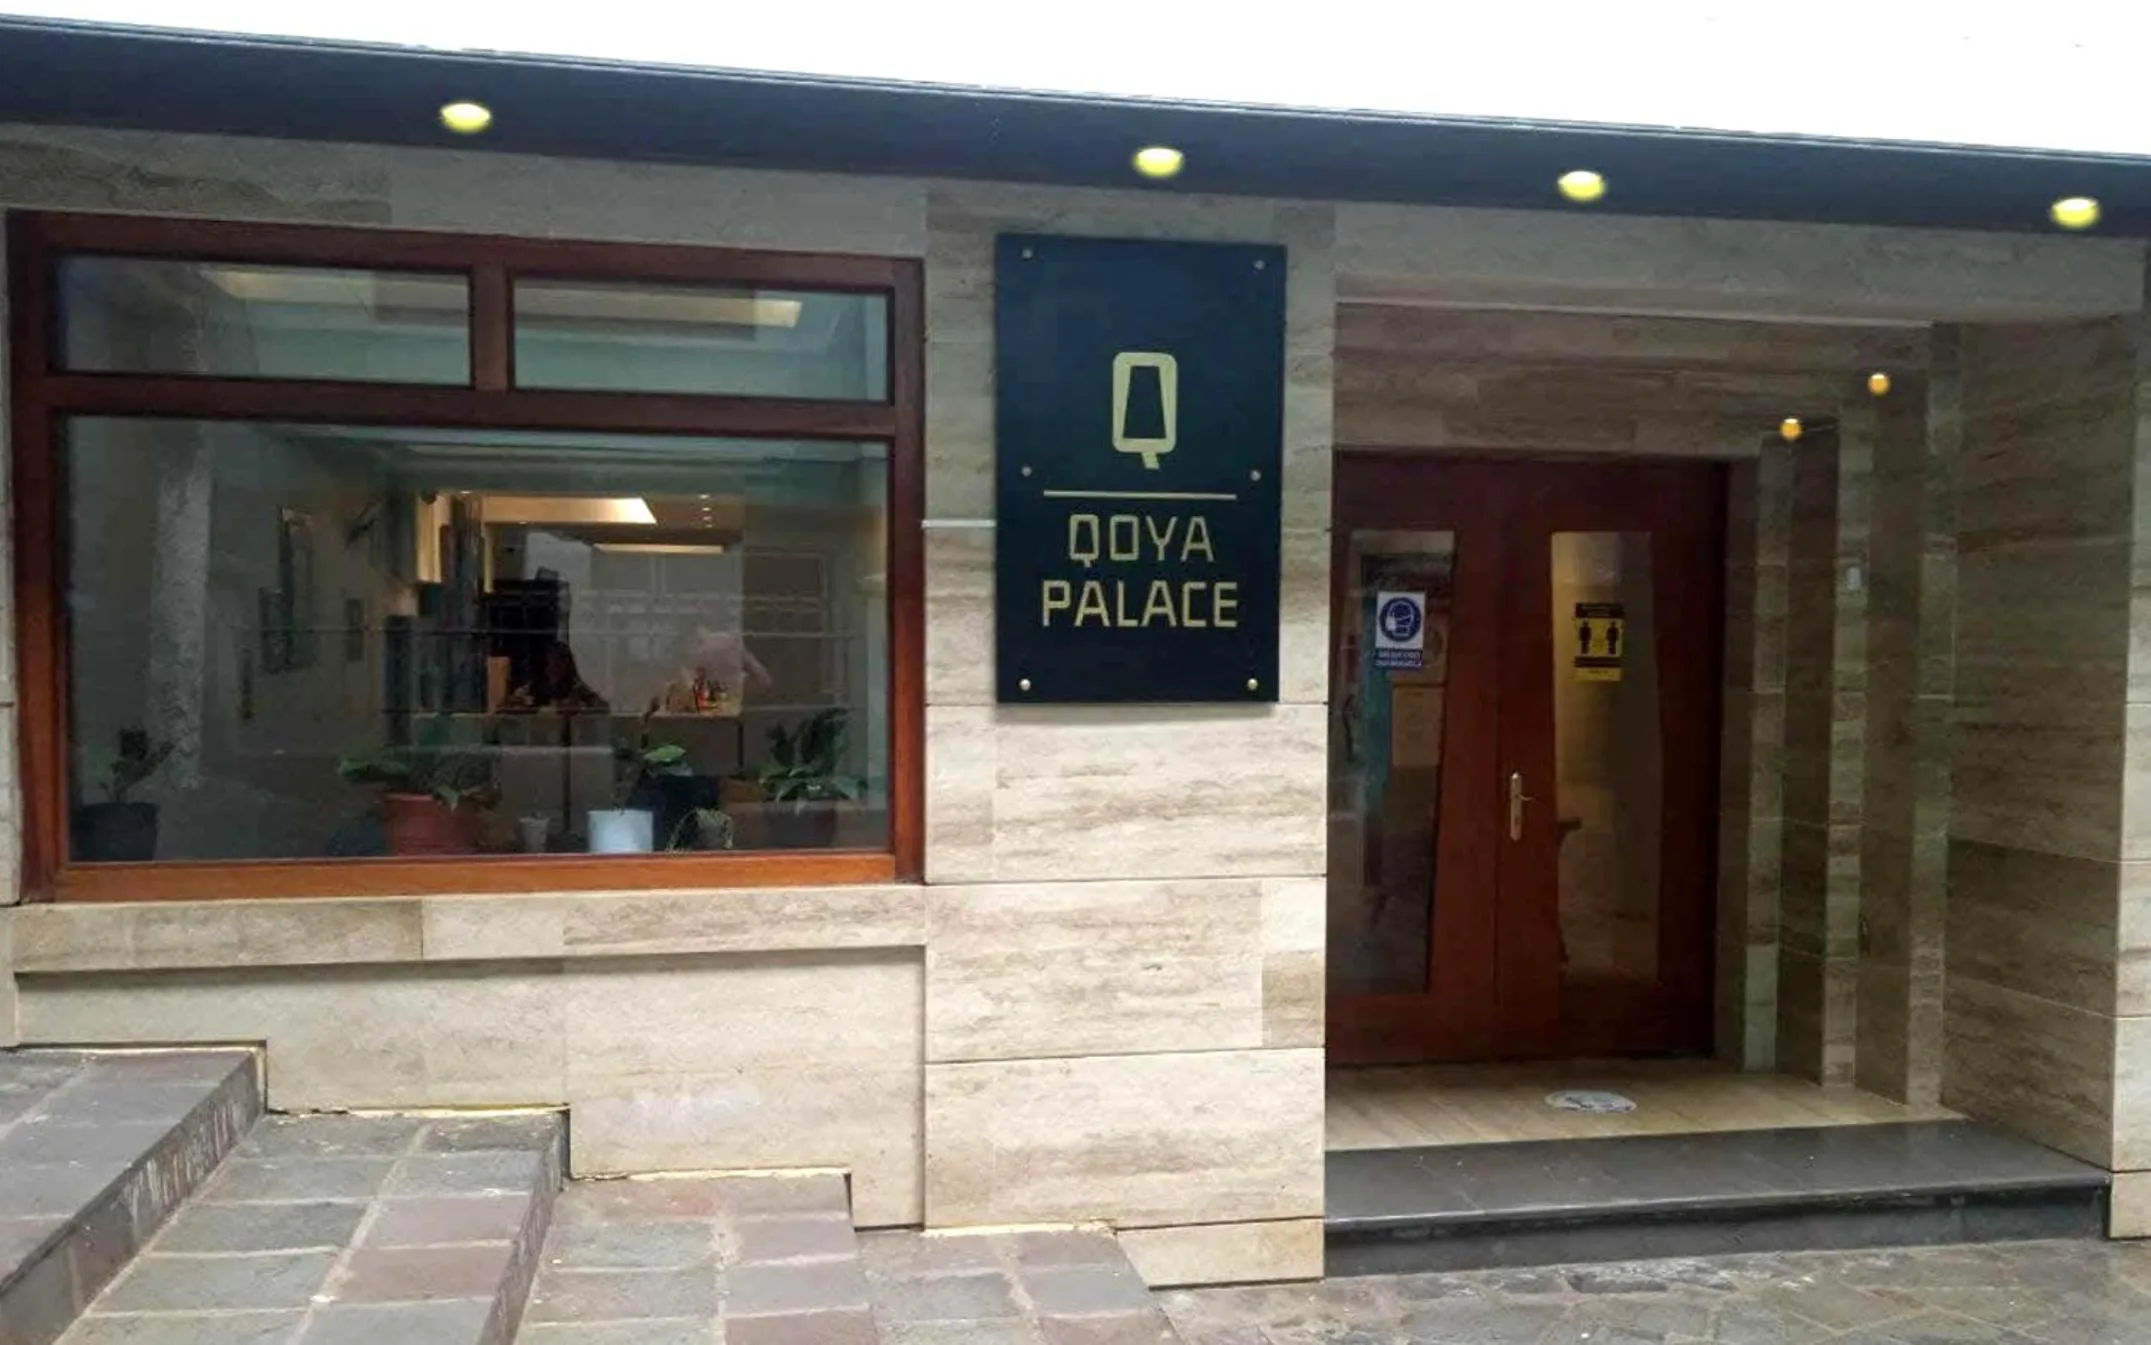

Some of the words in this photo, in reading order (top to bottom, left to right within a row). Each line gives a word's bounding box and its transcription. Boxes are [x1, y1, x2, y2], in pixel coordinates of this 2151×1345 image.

[1112, 352, 1177, 469] Q
[1069, 514, 1214, 567] QOYA
[1043, 580, 1238, 627] PALACE
